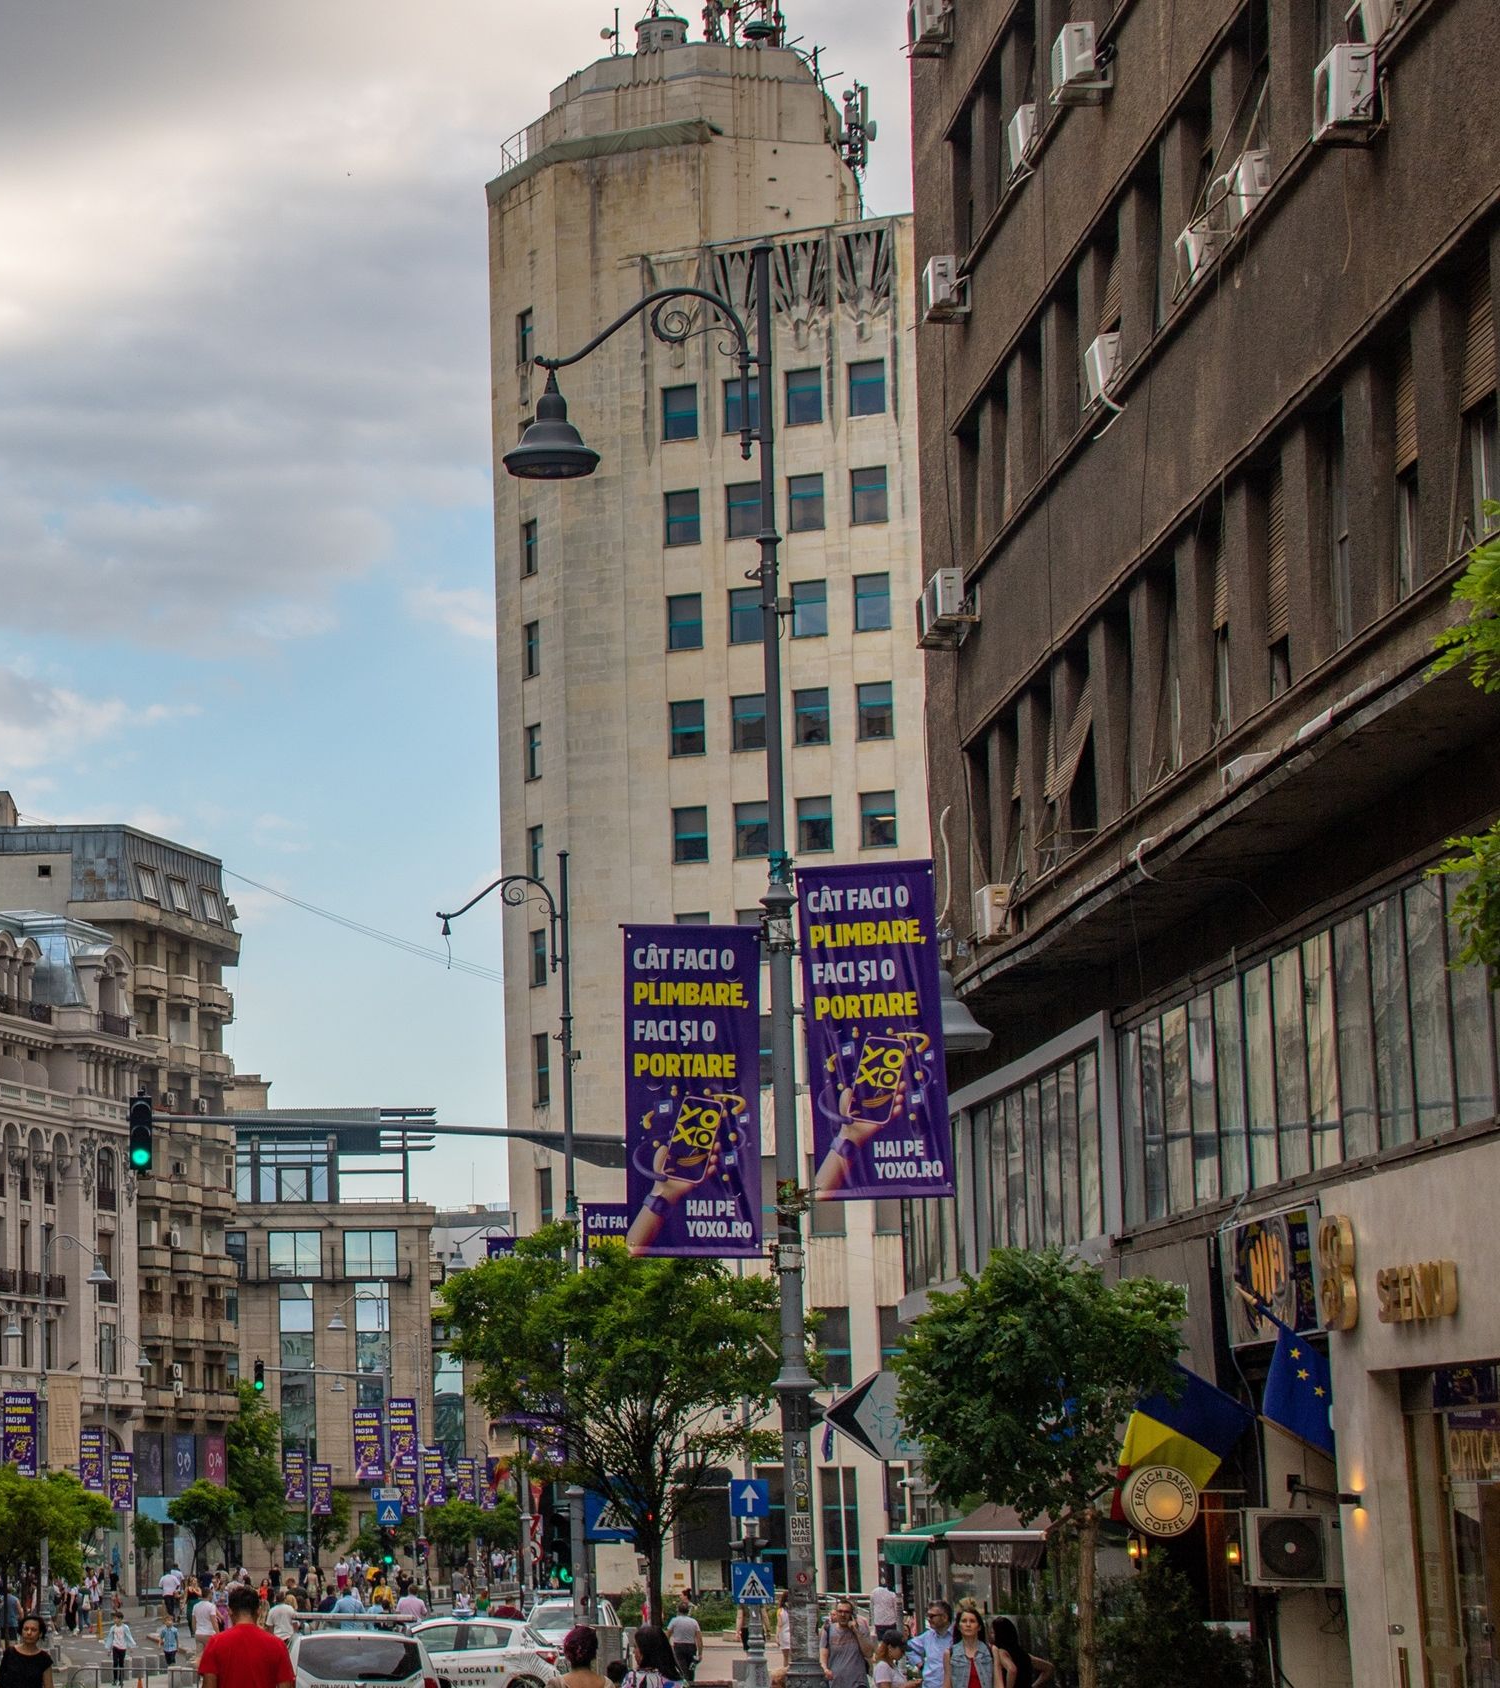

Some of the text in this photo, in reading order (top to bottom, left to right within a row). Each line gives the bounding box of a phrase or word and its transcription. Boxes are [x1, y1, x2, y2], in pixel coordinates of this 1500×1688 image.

[807, 885, 909, 913] CÂT FACI O
[809, 919, 927, 948] PLIMBARE,
[633, 943, 735, 970] CÂT FACI O
[812, 959, 896, 986] FACI ȘI O
[634, 982, 749, 1008] PLIMBARE,
[814, 991, 918, 1020] PORTARE
[634, 1020, 716, 1046] FACI ȘI O
[634, 1053, 736, 1078] PORTARE
[873, 1140, 924, 1158] HAI PE
[874, 1160, 943, 1179] YOXO.RO
[587, 1213, 607, 1228] CÂT
[686, 1200, 735, 1216] HAI PE
[686, 1221, 752, 1238] YOXO.RO
[1135, 1470, 1193, 1507] FRENCH BAKERY
[791, 1517, 810, 1529] BNE
[1145, 1517, 1186, 1532] COFFEE
